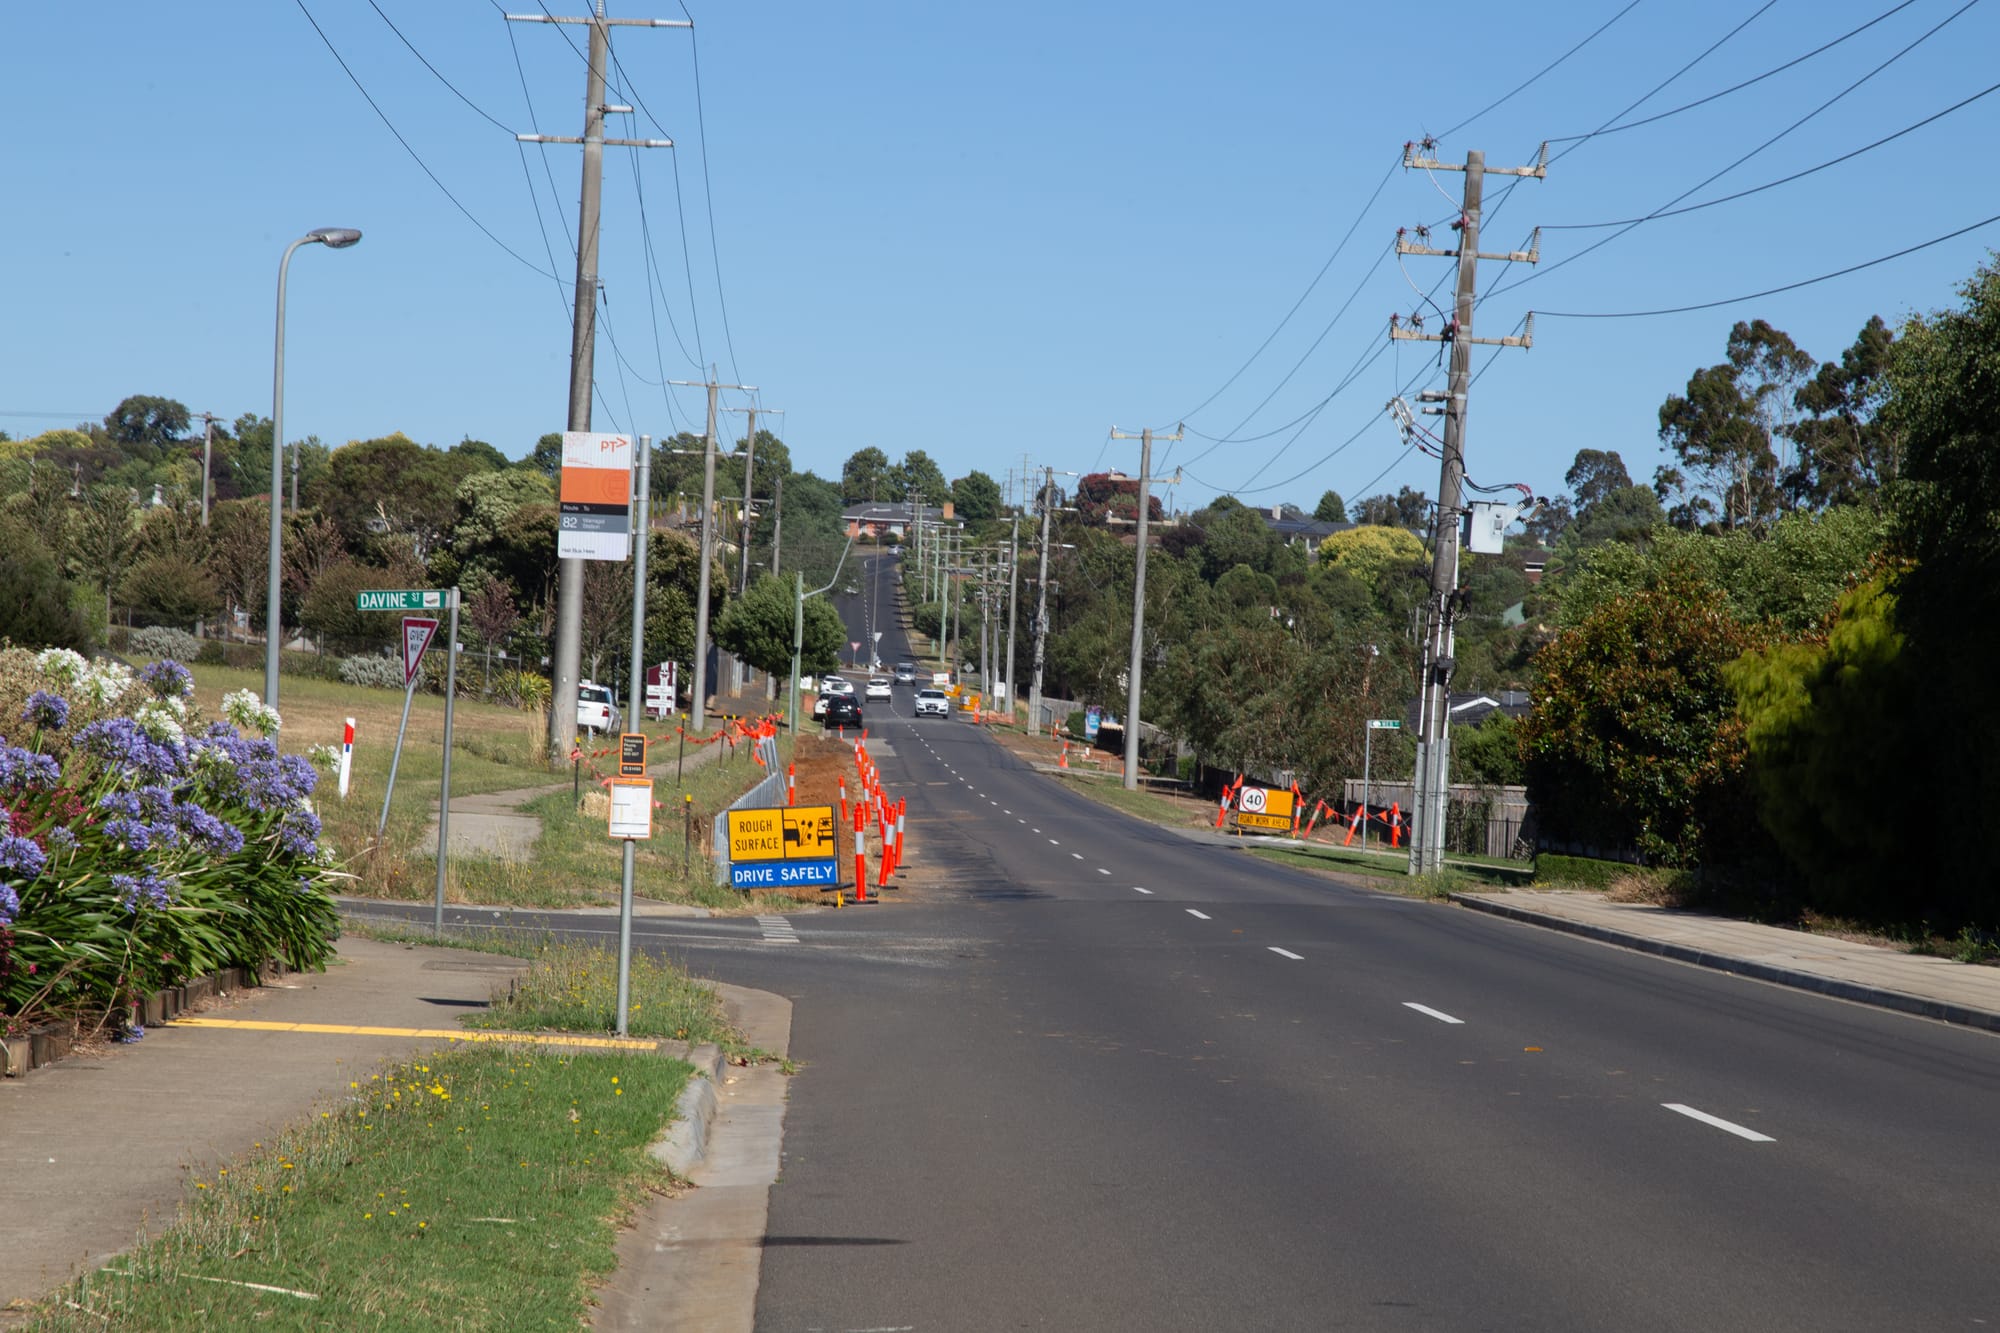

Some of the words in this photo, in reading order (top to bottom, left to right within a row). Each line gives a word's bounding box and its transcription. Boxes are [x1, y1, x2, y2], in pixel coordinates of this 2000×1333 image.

[562, 516, 577, 528] 82
[360, 592, 408, 608] DAVINE
[411, 592, 420, 602] ST
[409, 630, 425, 641] GIVE
[1246, 794, 1262, 806] 40
[739, 819, 773, 833] ROUGH
[735, 837, 779, 852] SURFACE
[734, 868, 775, 883] DRIVE
[780, 865, 833, 881] SAFELY
